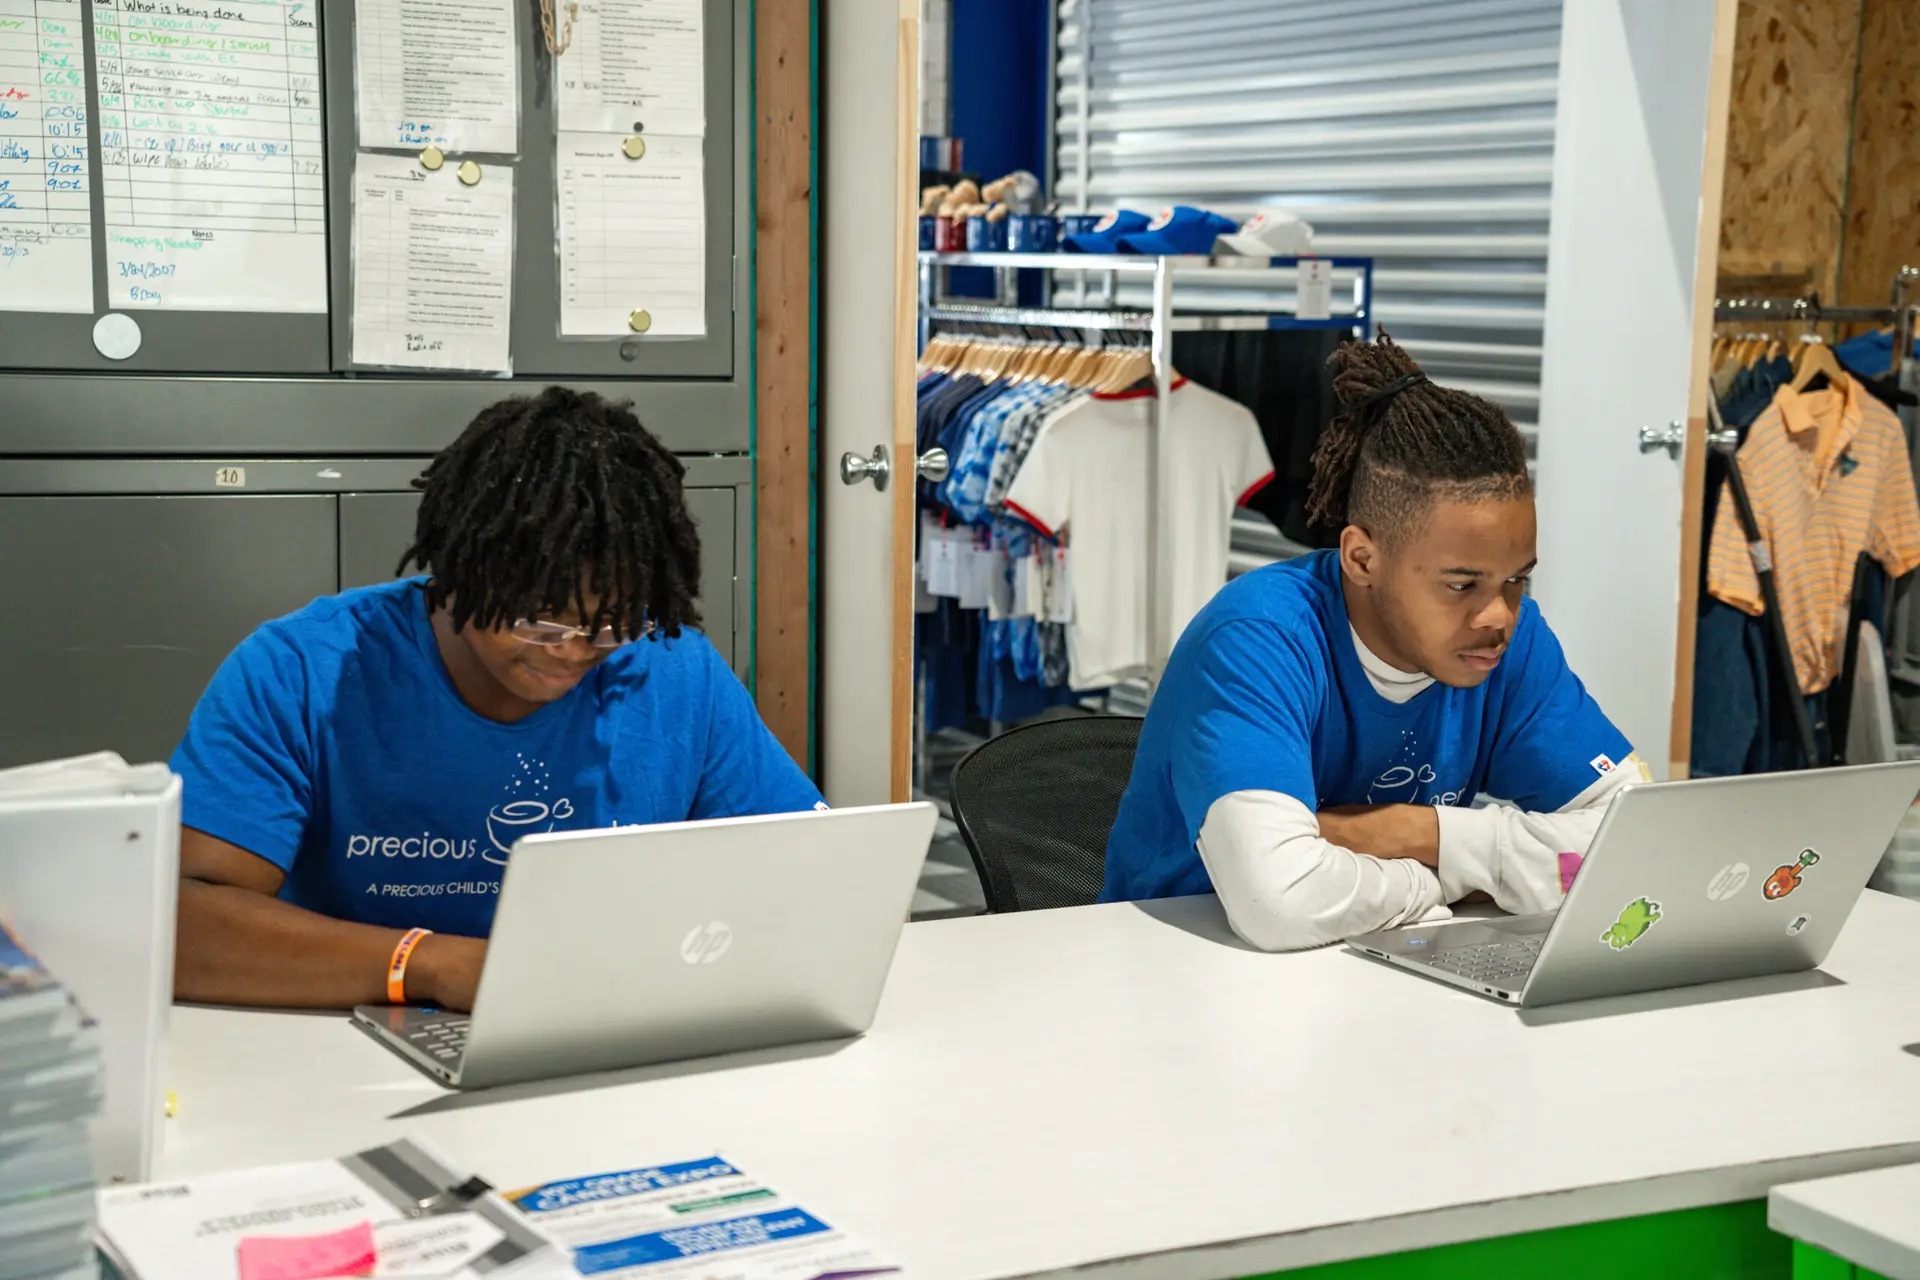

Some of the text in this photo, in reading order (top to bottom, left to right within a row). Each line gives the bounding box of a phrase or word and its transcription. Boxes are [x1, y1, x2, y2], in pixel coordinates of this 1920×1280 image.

[124, 0, 156, 13] What
[160, 3, 171, 14] is
[176, 3, 209, 19] being
[214, 8, 245, 21] done
[48, 122, 85, 137] 10:15
[192, 229, 214, 238] Notes
[222, 468, 239, 484] 10
[346, 830, 477, 860] precious
[365, 881, 499, 898] A PRECIOUS CHILD'S
[1707, 862, 1751, 902] hp
[680, 920, 734, 964] hp
